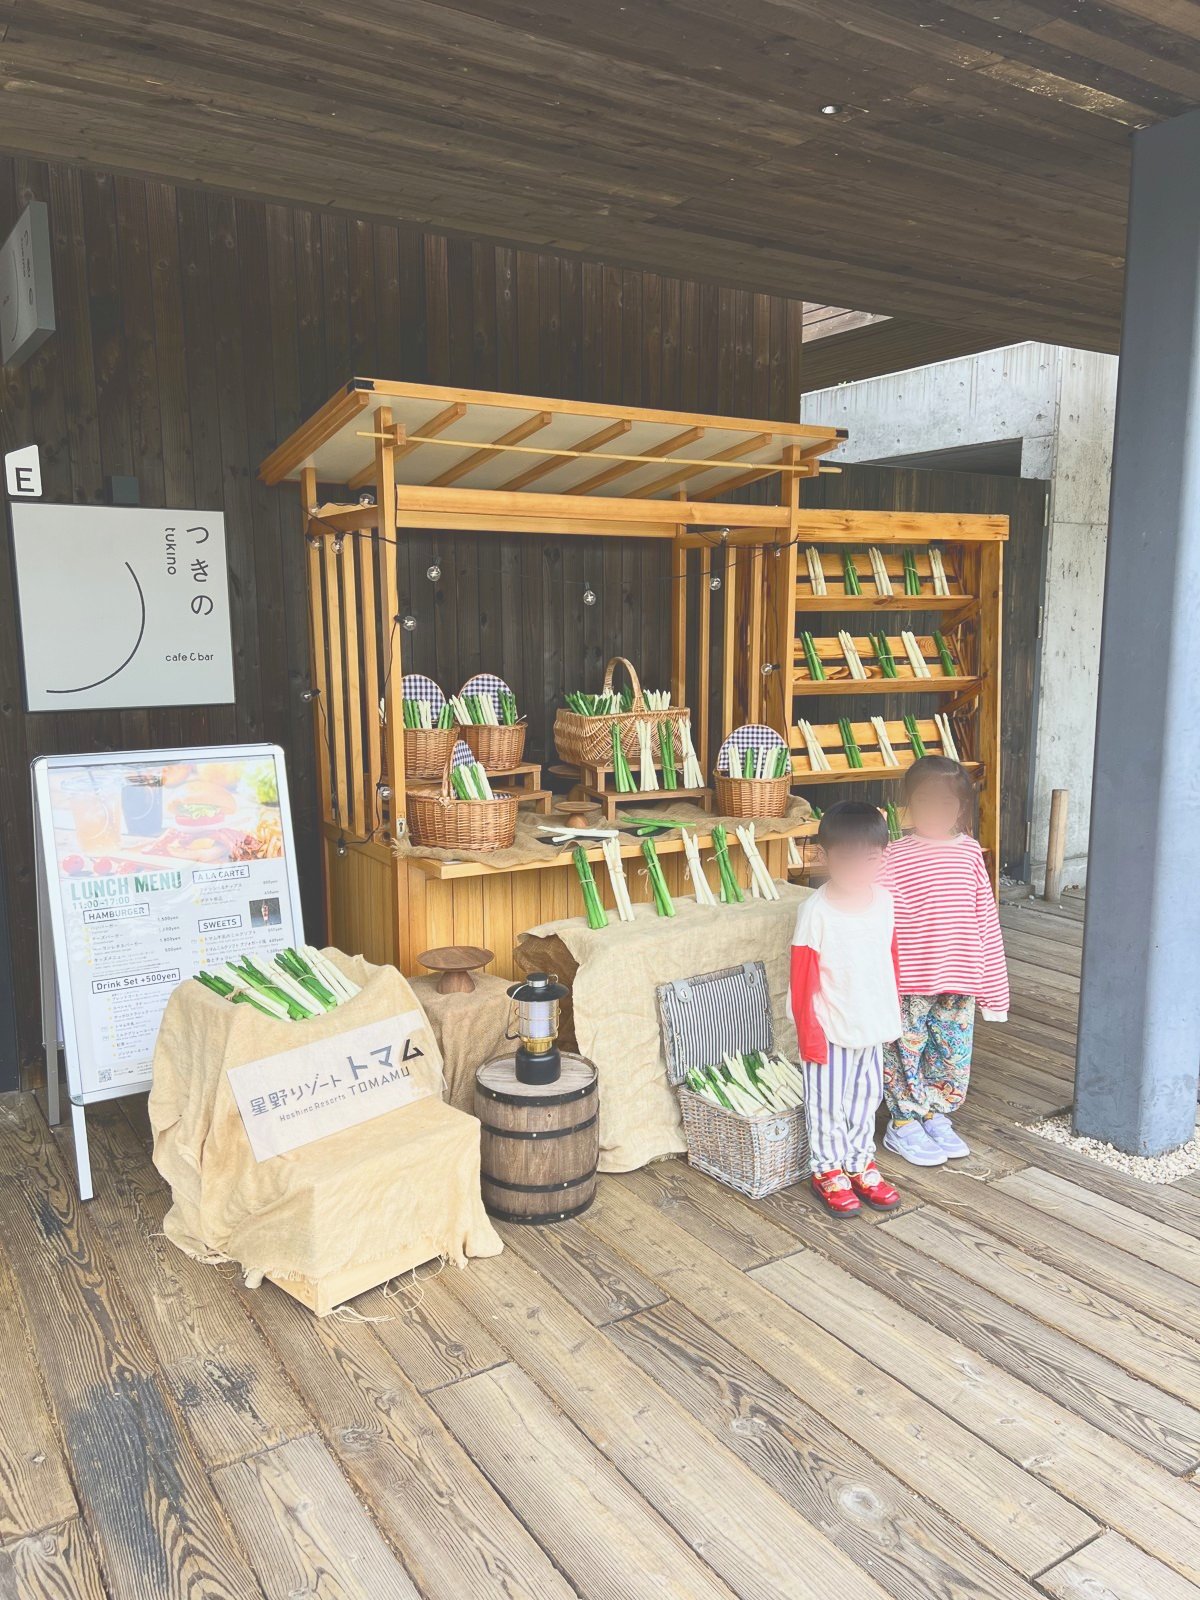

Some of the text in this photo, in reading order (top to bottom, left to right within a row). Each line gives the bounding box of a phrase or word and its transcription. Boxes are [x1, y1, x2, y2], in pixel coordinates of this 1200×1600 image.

[15, 467, 35, 493] E
[165, 527, 177, 576] tukino
[186, 526, 214, 616] つきの
[165, 653, 188, 662] cafe
[197, 652, 214, 662] bar
[70, 871, 182, 901] LUNCH MENU
[218, 869, 245, 879] CARTE
[89, 907, 145, 921] HAMBURGER
[203, 918, 237, 930] SWEETS
[96, 972, 177, 991] Drink Set +500yen
[250, 1038, 425, 1116] 星野リゾート トマム
[279, 1066, 410, 1122] Hoshino Resorts TOMAMU
